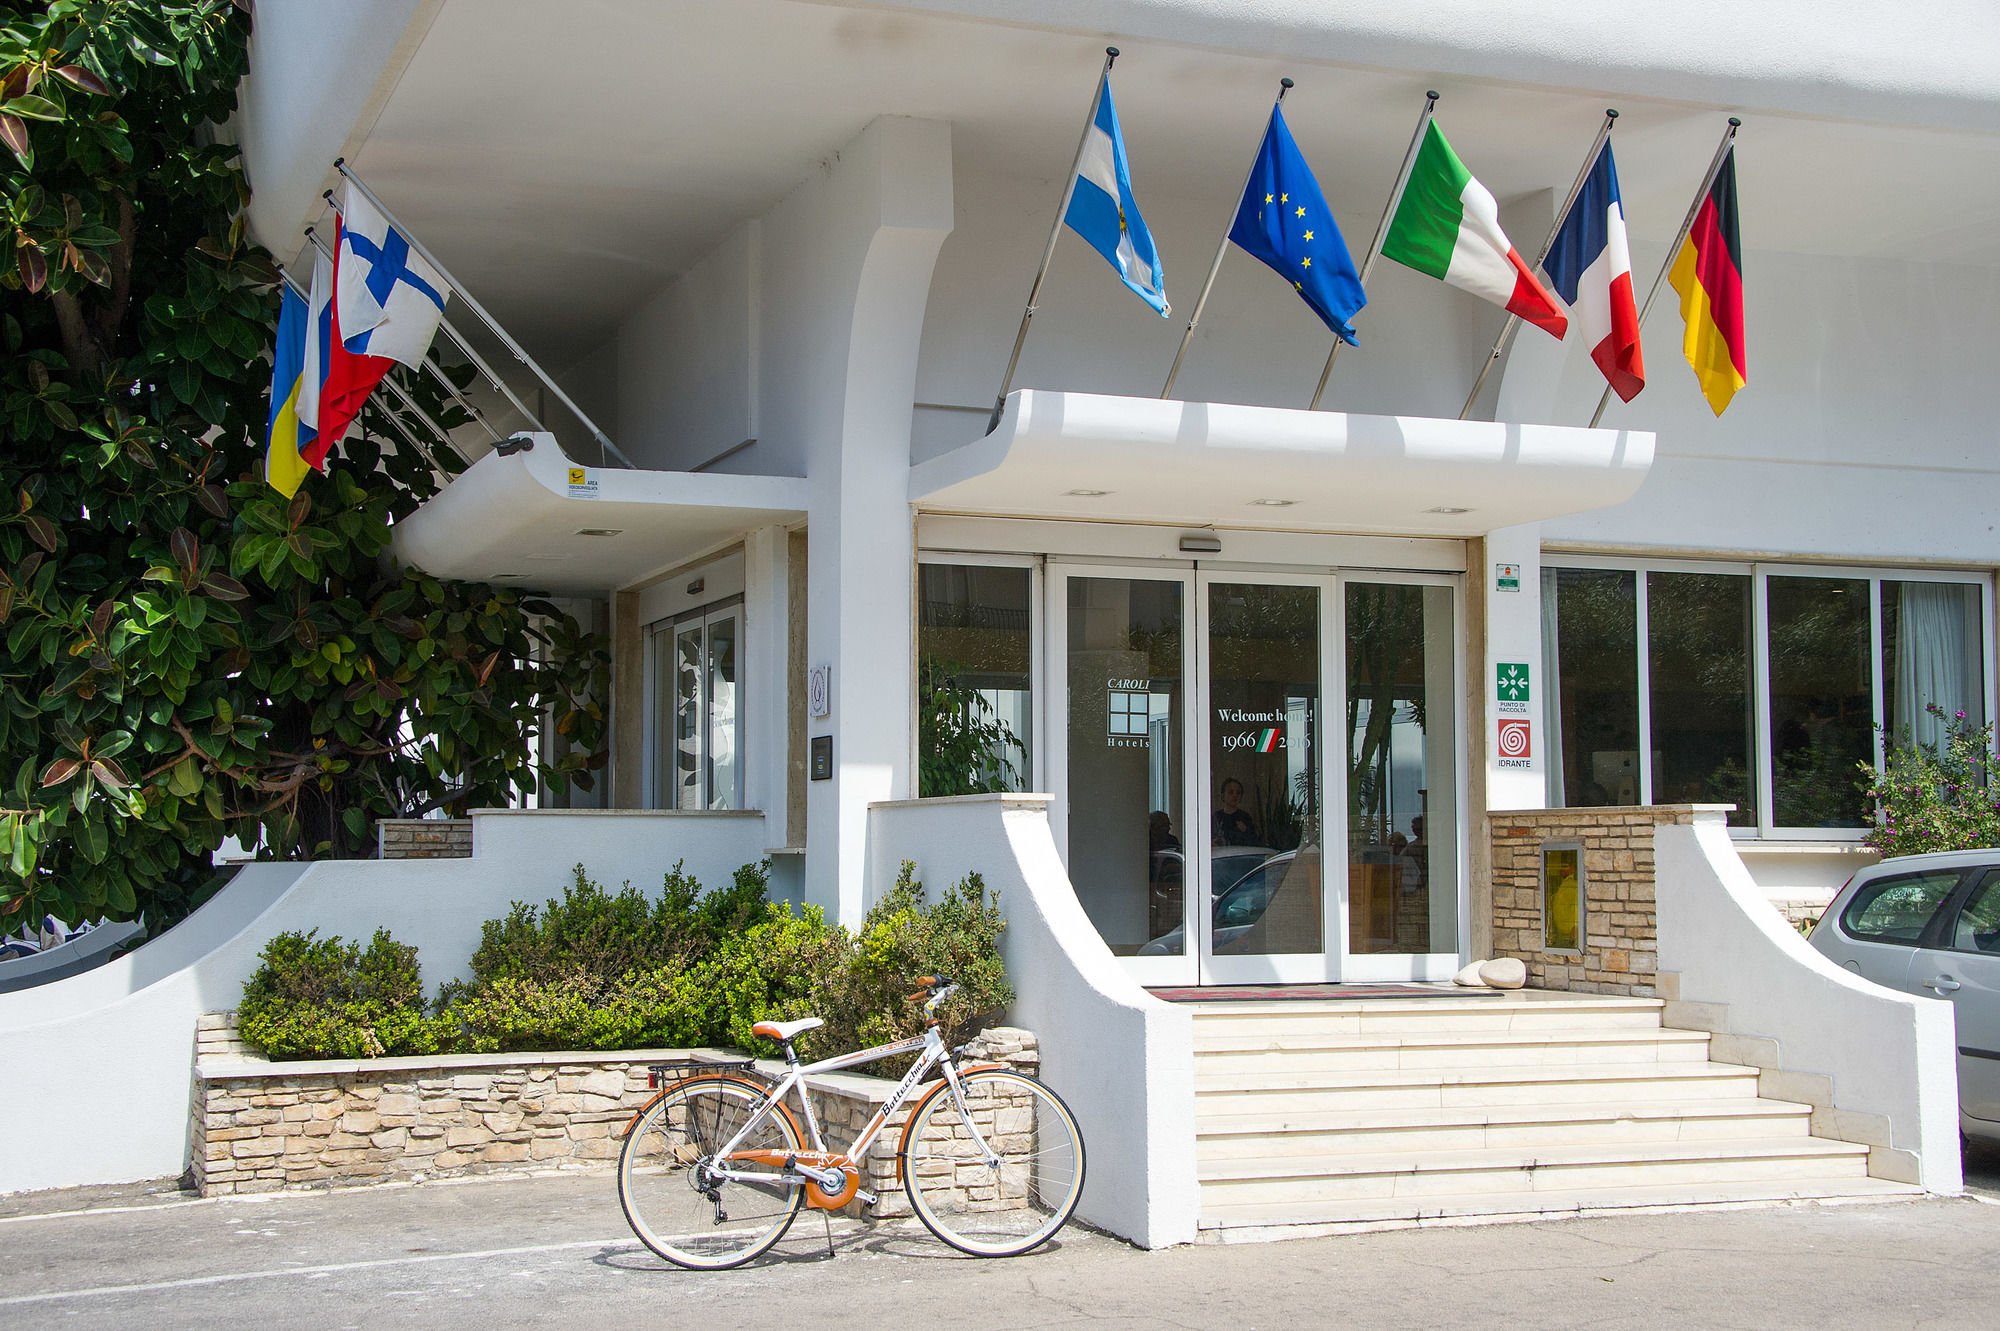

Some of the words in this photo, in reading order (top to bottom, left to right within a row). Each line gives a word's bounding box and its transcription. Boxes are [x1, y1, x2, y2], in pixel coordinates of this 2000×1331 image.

[1107, 678, 1151, 690] CAROLI
[1218, 708, 1274, 722] Welcome
[1275, 708, 1313, 722] home!
[1107, 738, 1150, 747] Hotels
[1222, 731, 1256, 752] 1966
[1498, 759, 1531, 768] IDRANTE
[882, 1063, 922, 1117] Bottecchia
